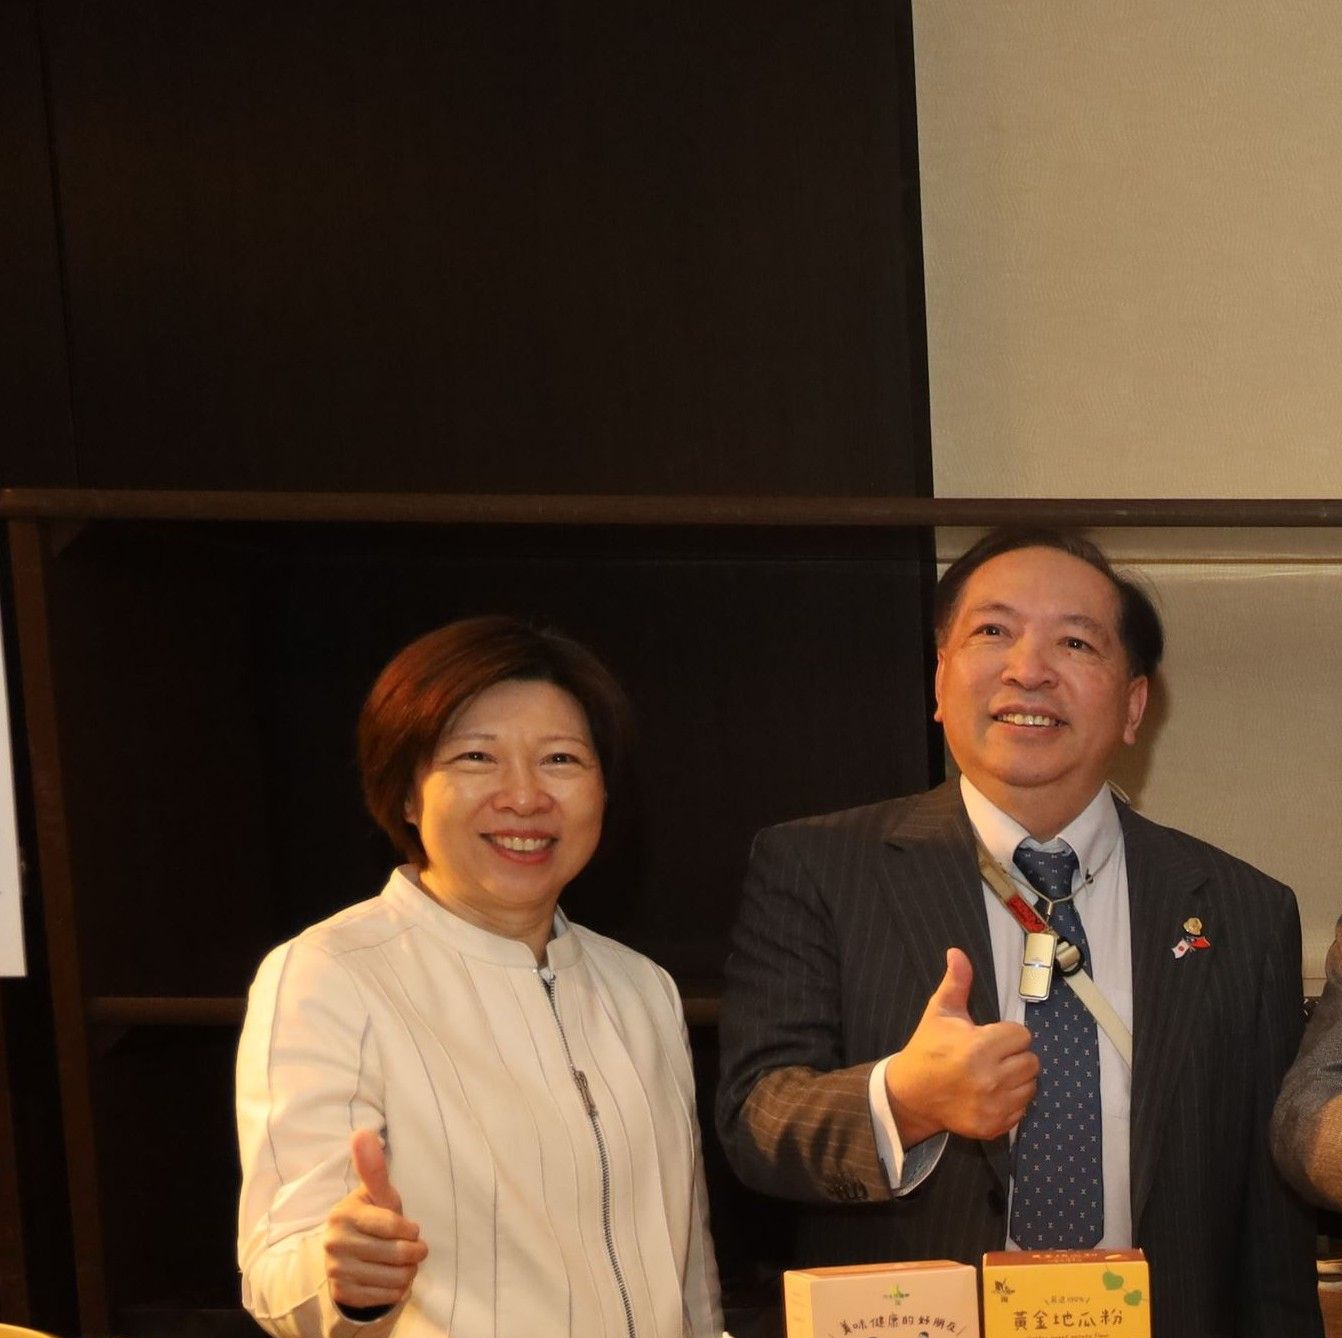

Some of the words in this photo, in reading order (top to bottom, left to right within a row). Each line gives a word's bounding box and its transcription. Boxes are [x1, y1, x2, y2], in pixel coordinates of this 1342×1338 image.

[1013, 1308, 1123, 1332] 黃金地瓜粉
